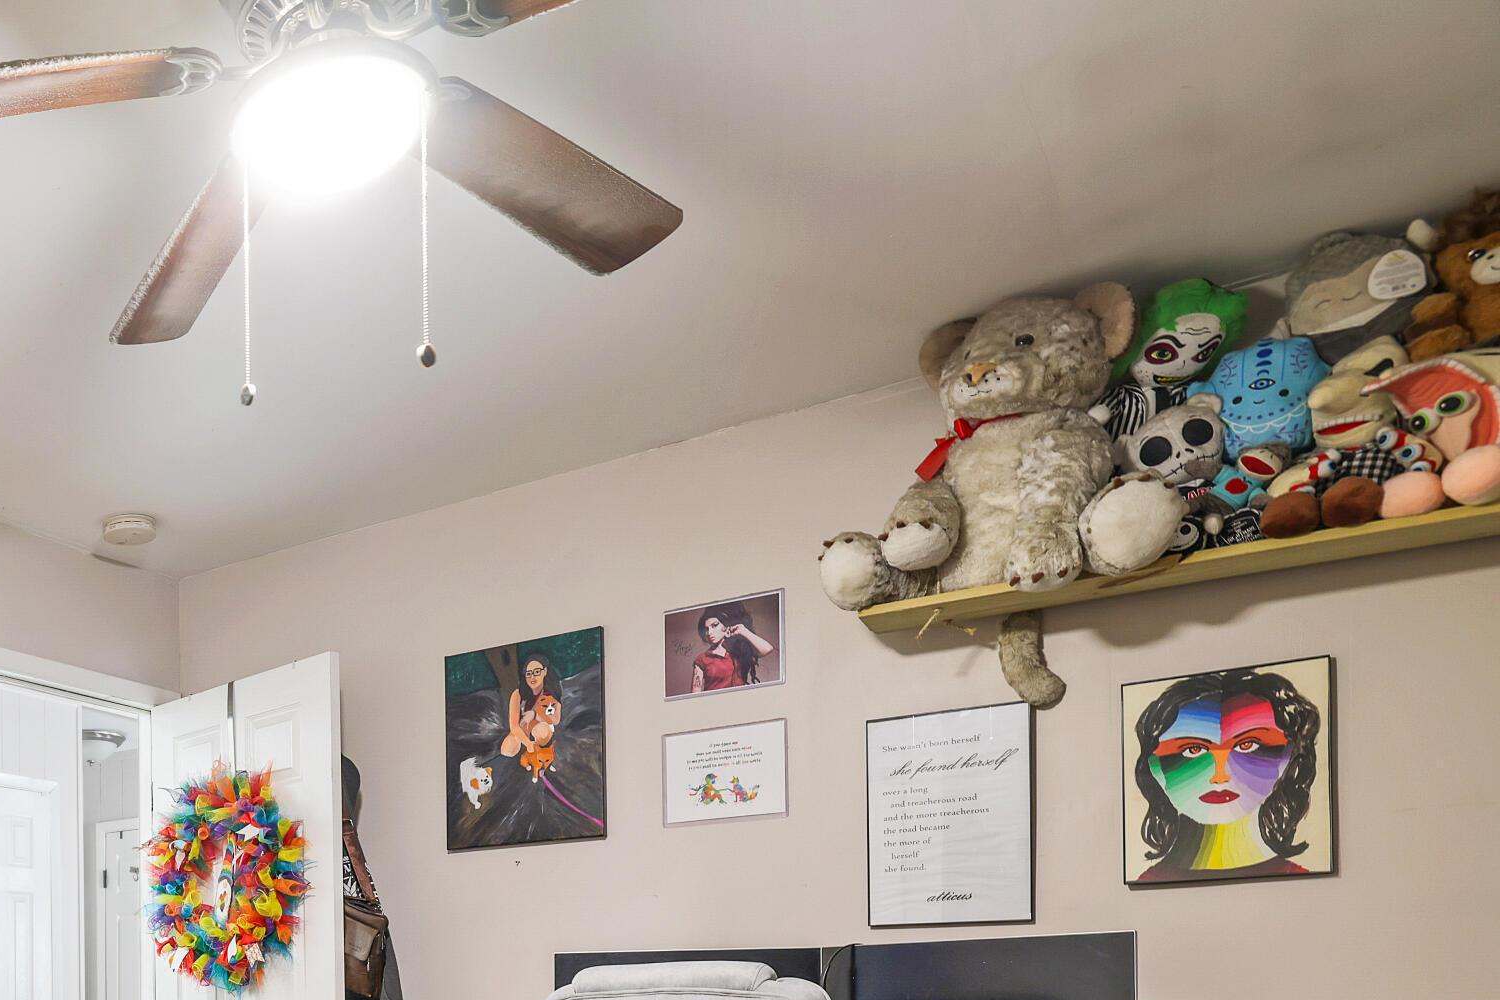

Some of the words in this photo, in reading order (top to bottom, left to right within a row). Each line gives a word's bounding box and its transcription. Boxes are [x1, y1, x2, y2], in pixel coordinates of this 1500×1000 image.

[882, 745, 897, 753] She
[900, 741, 926, 751] wasn't
[929, 740, 949, 748] born
[951, 734, 981, 745] herself
[889, 760, 913, 777] she
[909, 757, 963, 779] found
[960, 748, 1019, 771] herself
[910, 787, 929, 795] long
[890, 800, 905, 809] and
[907, 798, 956, 807] treacherous
[958, 793, 978, 802] road
[883, 813, 898, 822] and
[900, 812, 913, 821] the
[940, 808, 990, 817] treacherous
[883, 827, 896, 835] the
[898, 825, 917, 834] road
[919, 824, 951, 832] became
[923, 836, 932, 845] of
[891, 850, 920, 860] herself
[884, 865, 898, 873] she
[900, 864, 927, 872] found.
[926, 890, 973, 903] atticus
